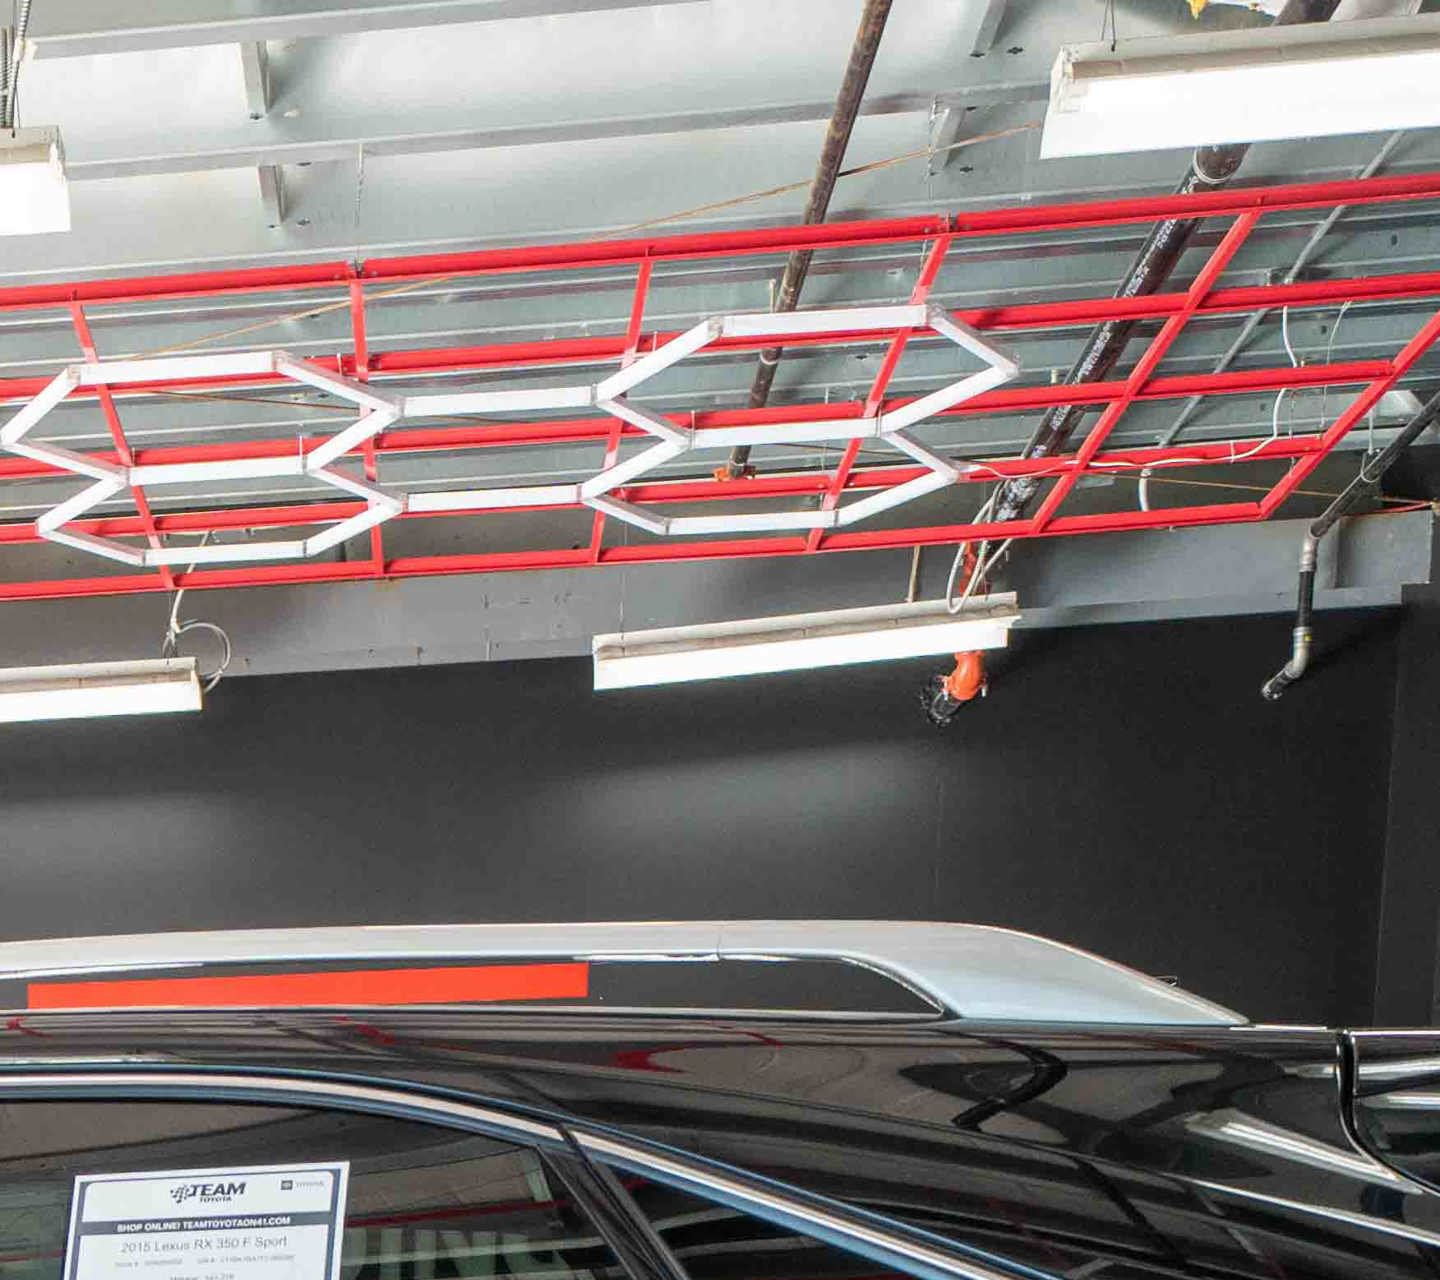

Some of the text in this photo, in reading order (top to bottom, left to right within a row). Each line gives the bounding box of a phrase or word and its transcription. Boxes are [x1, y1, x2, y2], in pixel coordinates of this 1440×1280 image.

[189, 1182, 247, 1196] TEAM
[117, 1216, 291, 1233] SHOP ONLINE! TEAMTOYOTAON41.COM
[122, 1235, 288, 1253] 2015 Lexus RX 350 F Sport
